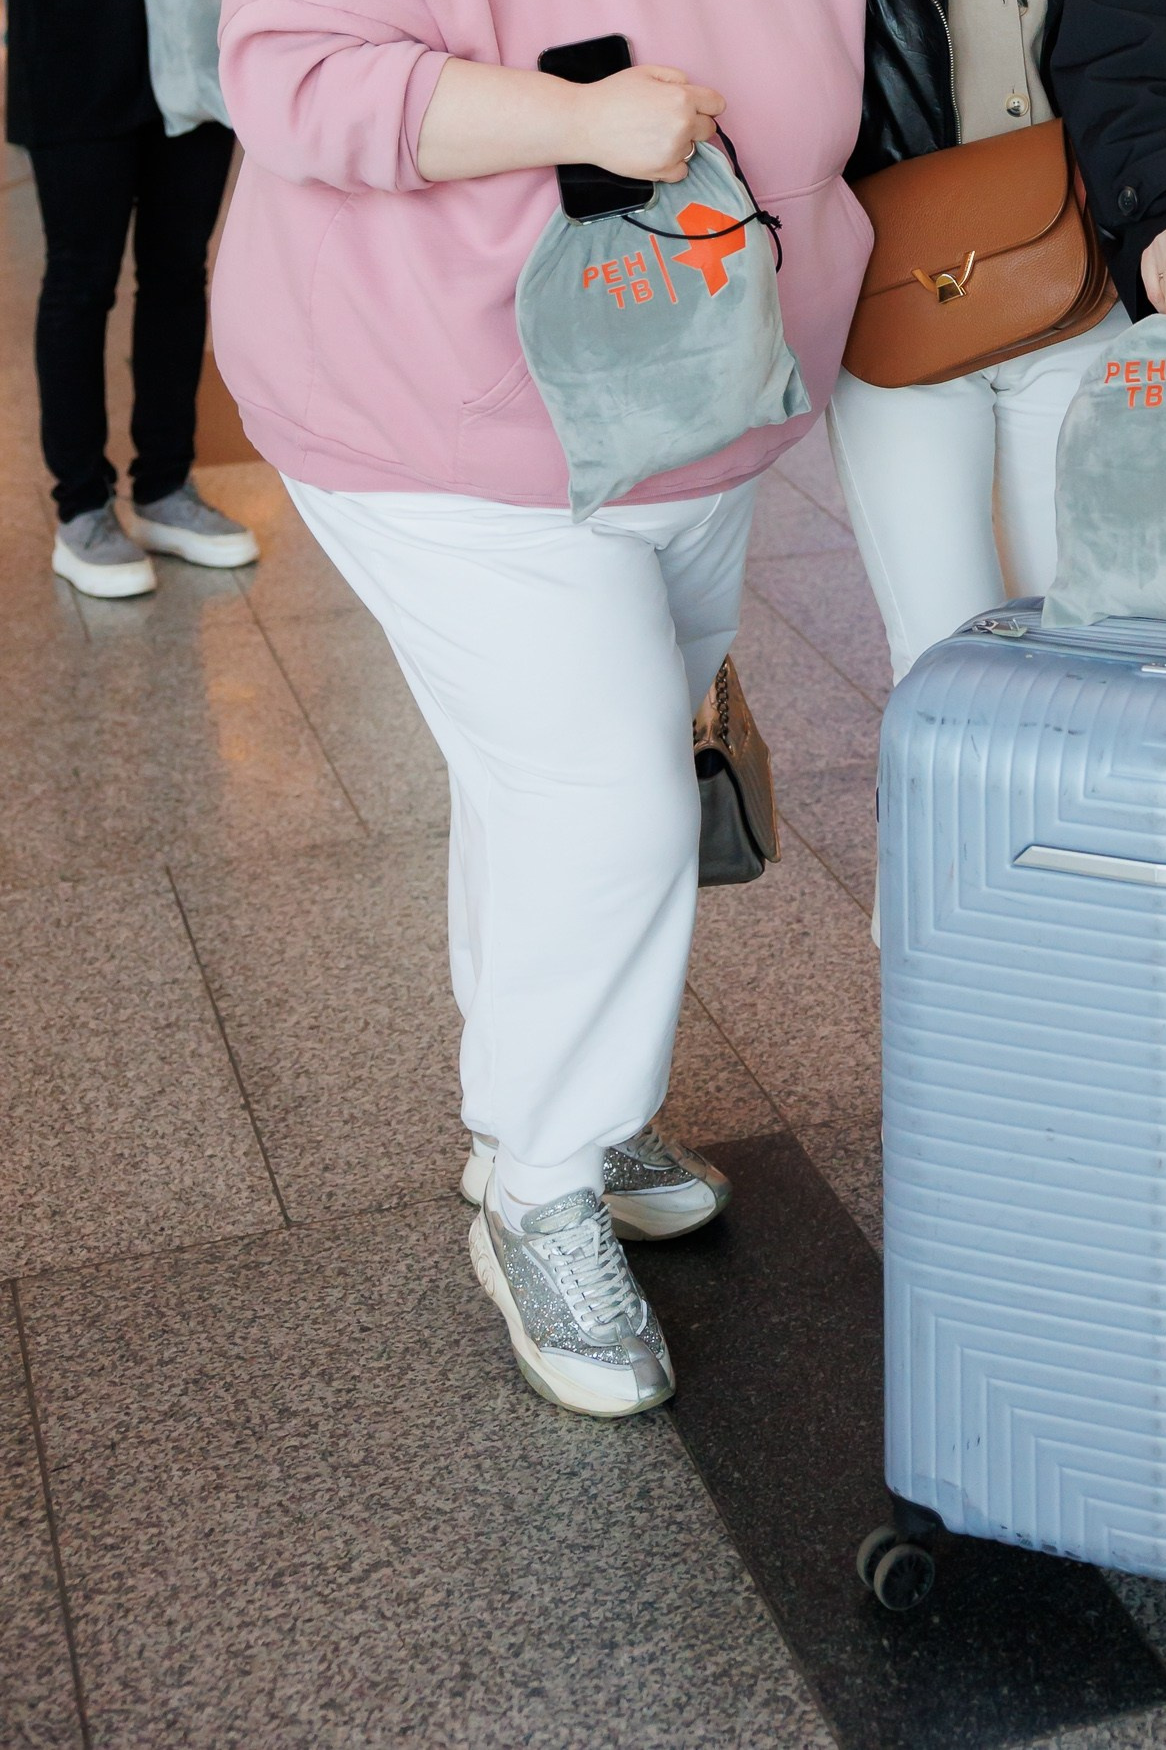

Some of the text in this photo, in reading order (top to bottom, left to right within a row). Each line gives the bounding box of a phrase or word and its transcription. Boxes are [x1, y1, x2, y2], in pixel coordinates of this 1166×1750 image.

[582, 251, 647, 289] РЕН
[607, 278, 654, 309] ТВ
[1104, 359, 1166, 384] РЕН
[1126, 384, 1164, 409] ТВ
